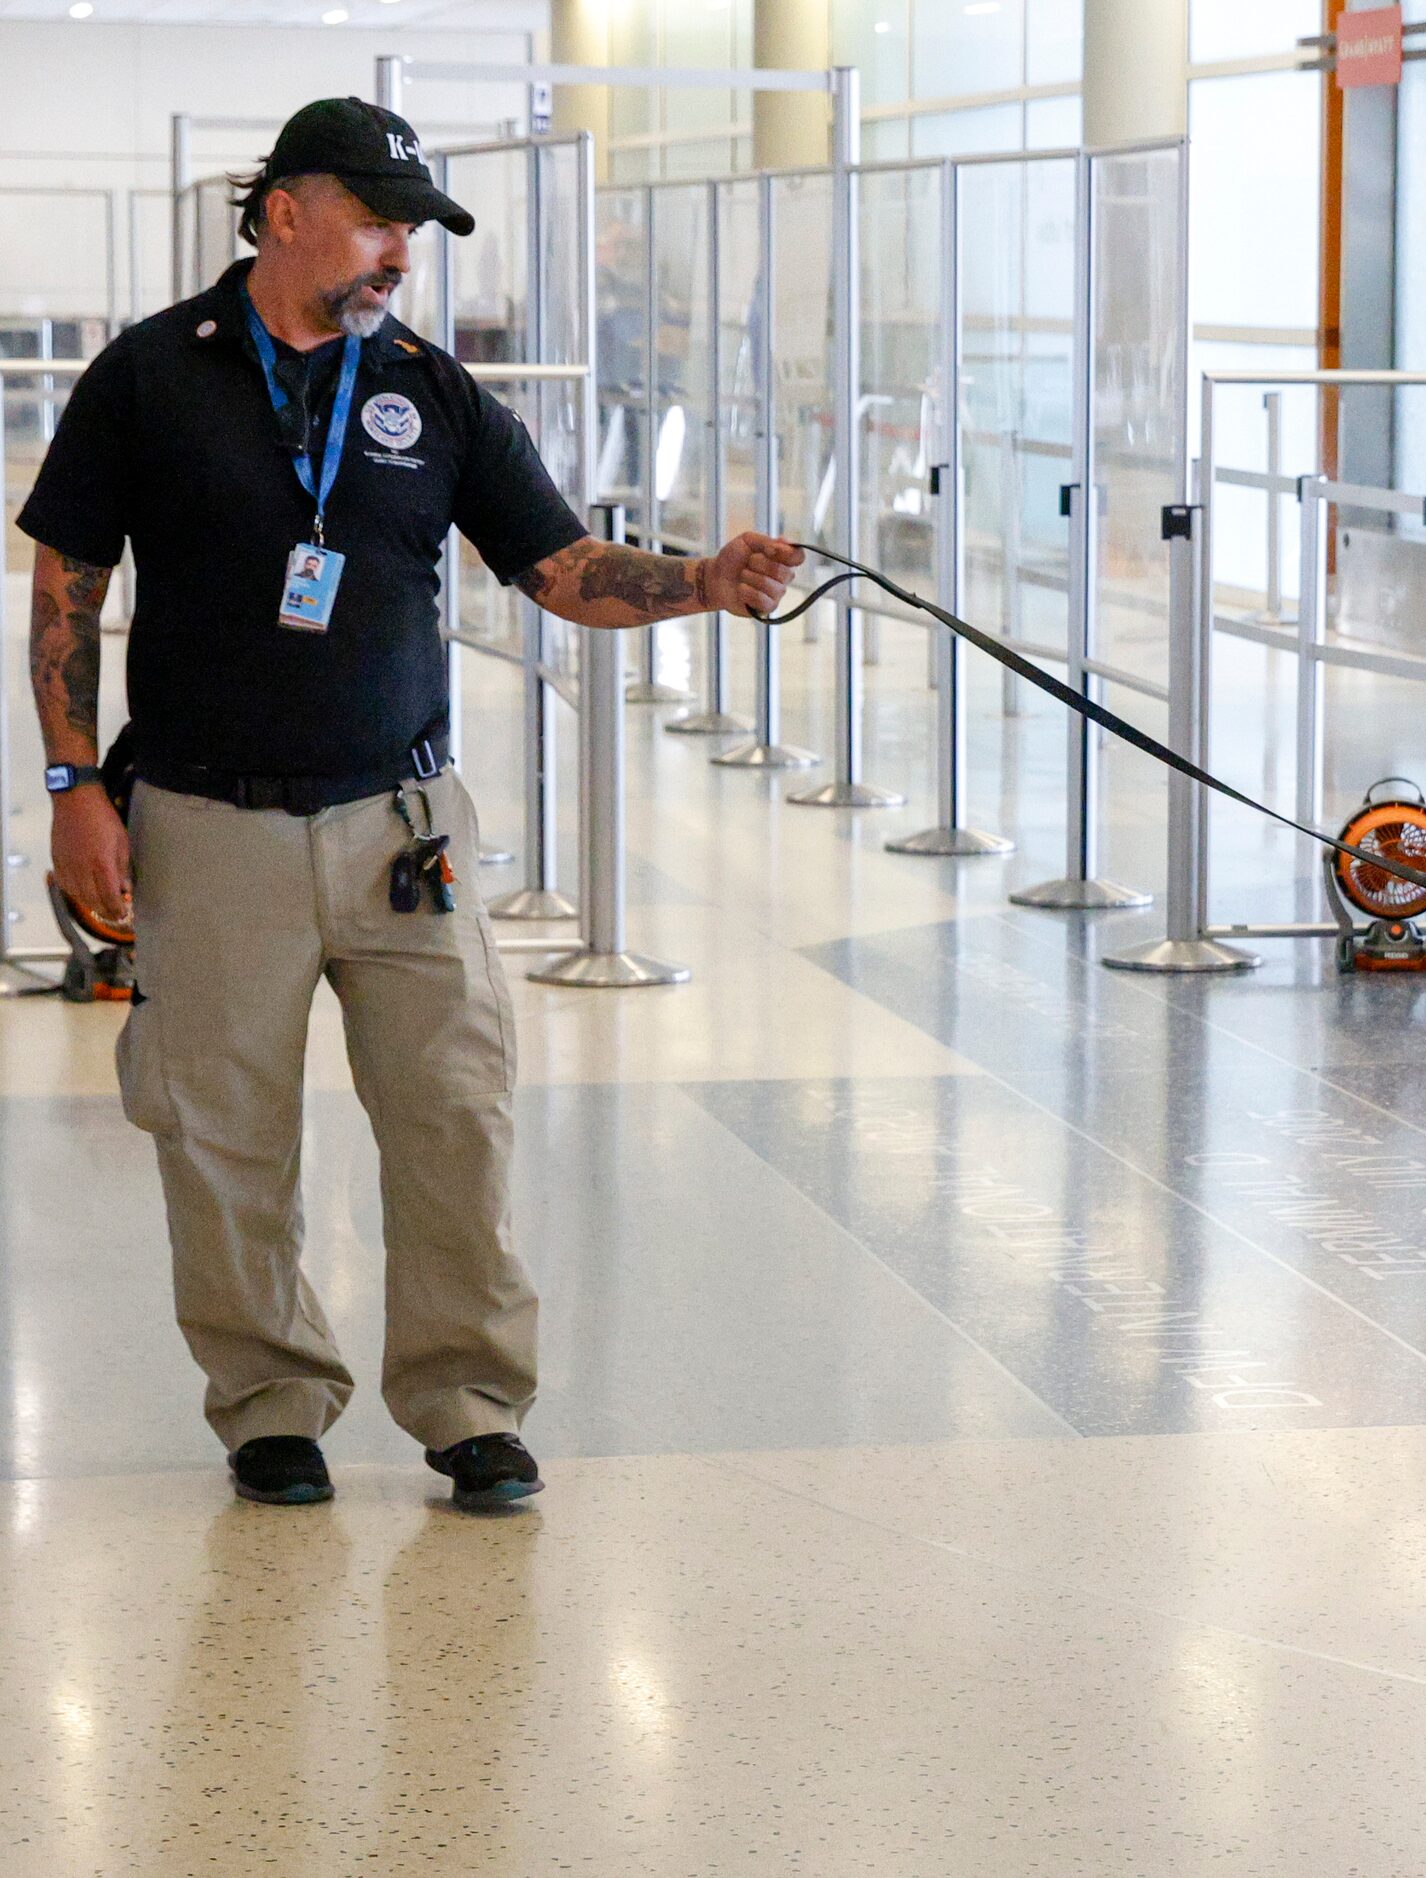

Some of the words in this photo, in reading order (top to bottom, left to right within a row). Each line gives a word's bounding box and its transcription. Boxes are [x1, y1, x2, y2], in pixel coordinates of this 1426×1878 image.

[386, 133, 427, 165] K-
[1184, 1152, 1271, 1166] D
[917, 1164, 1223, 1335] INTERNATIONAL
[1146, 1349, 1323, 1408] DFW
